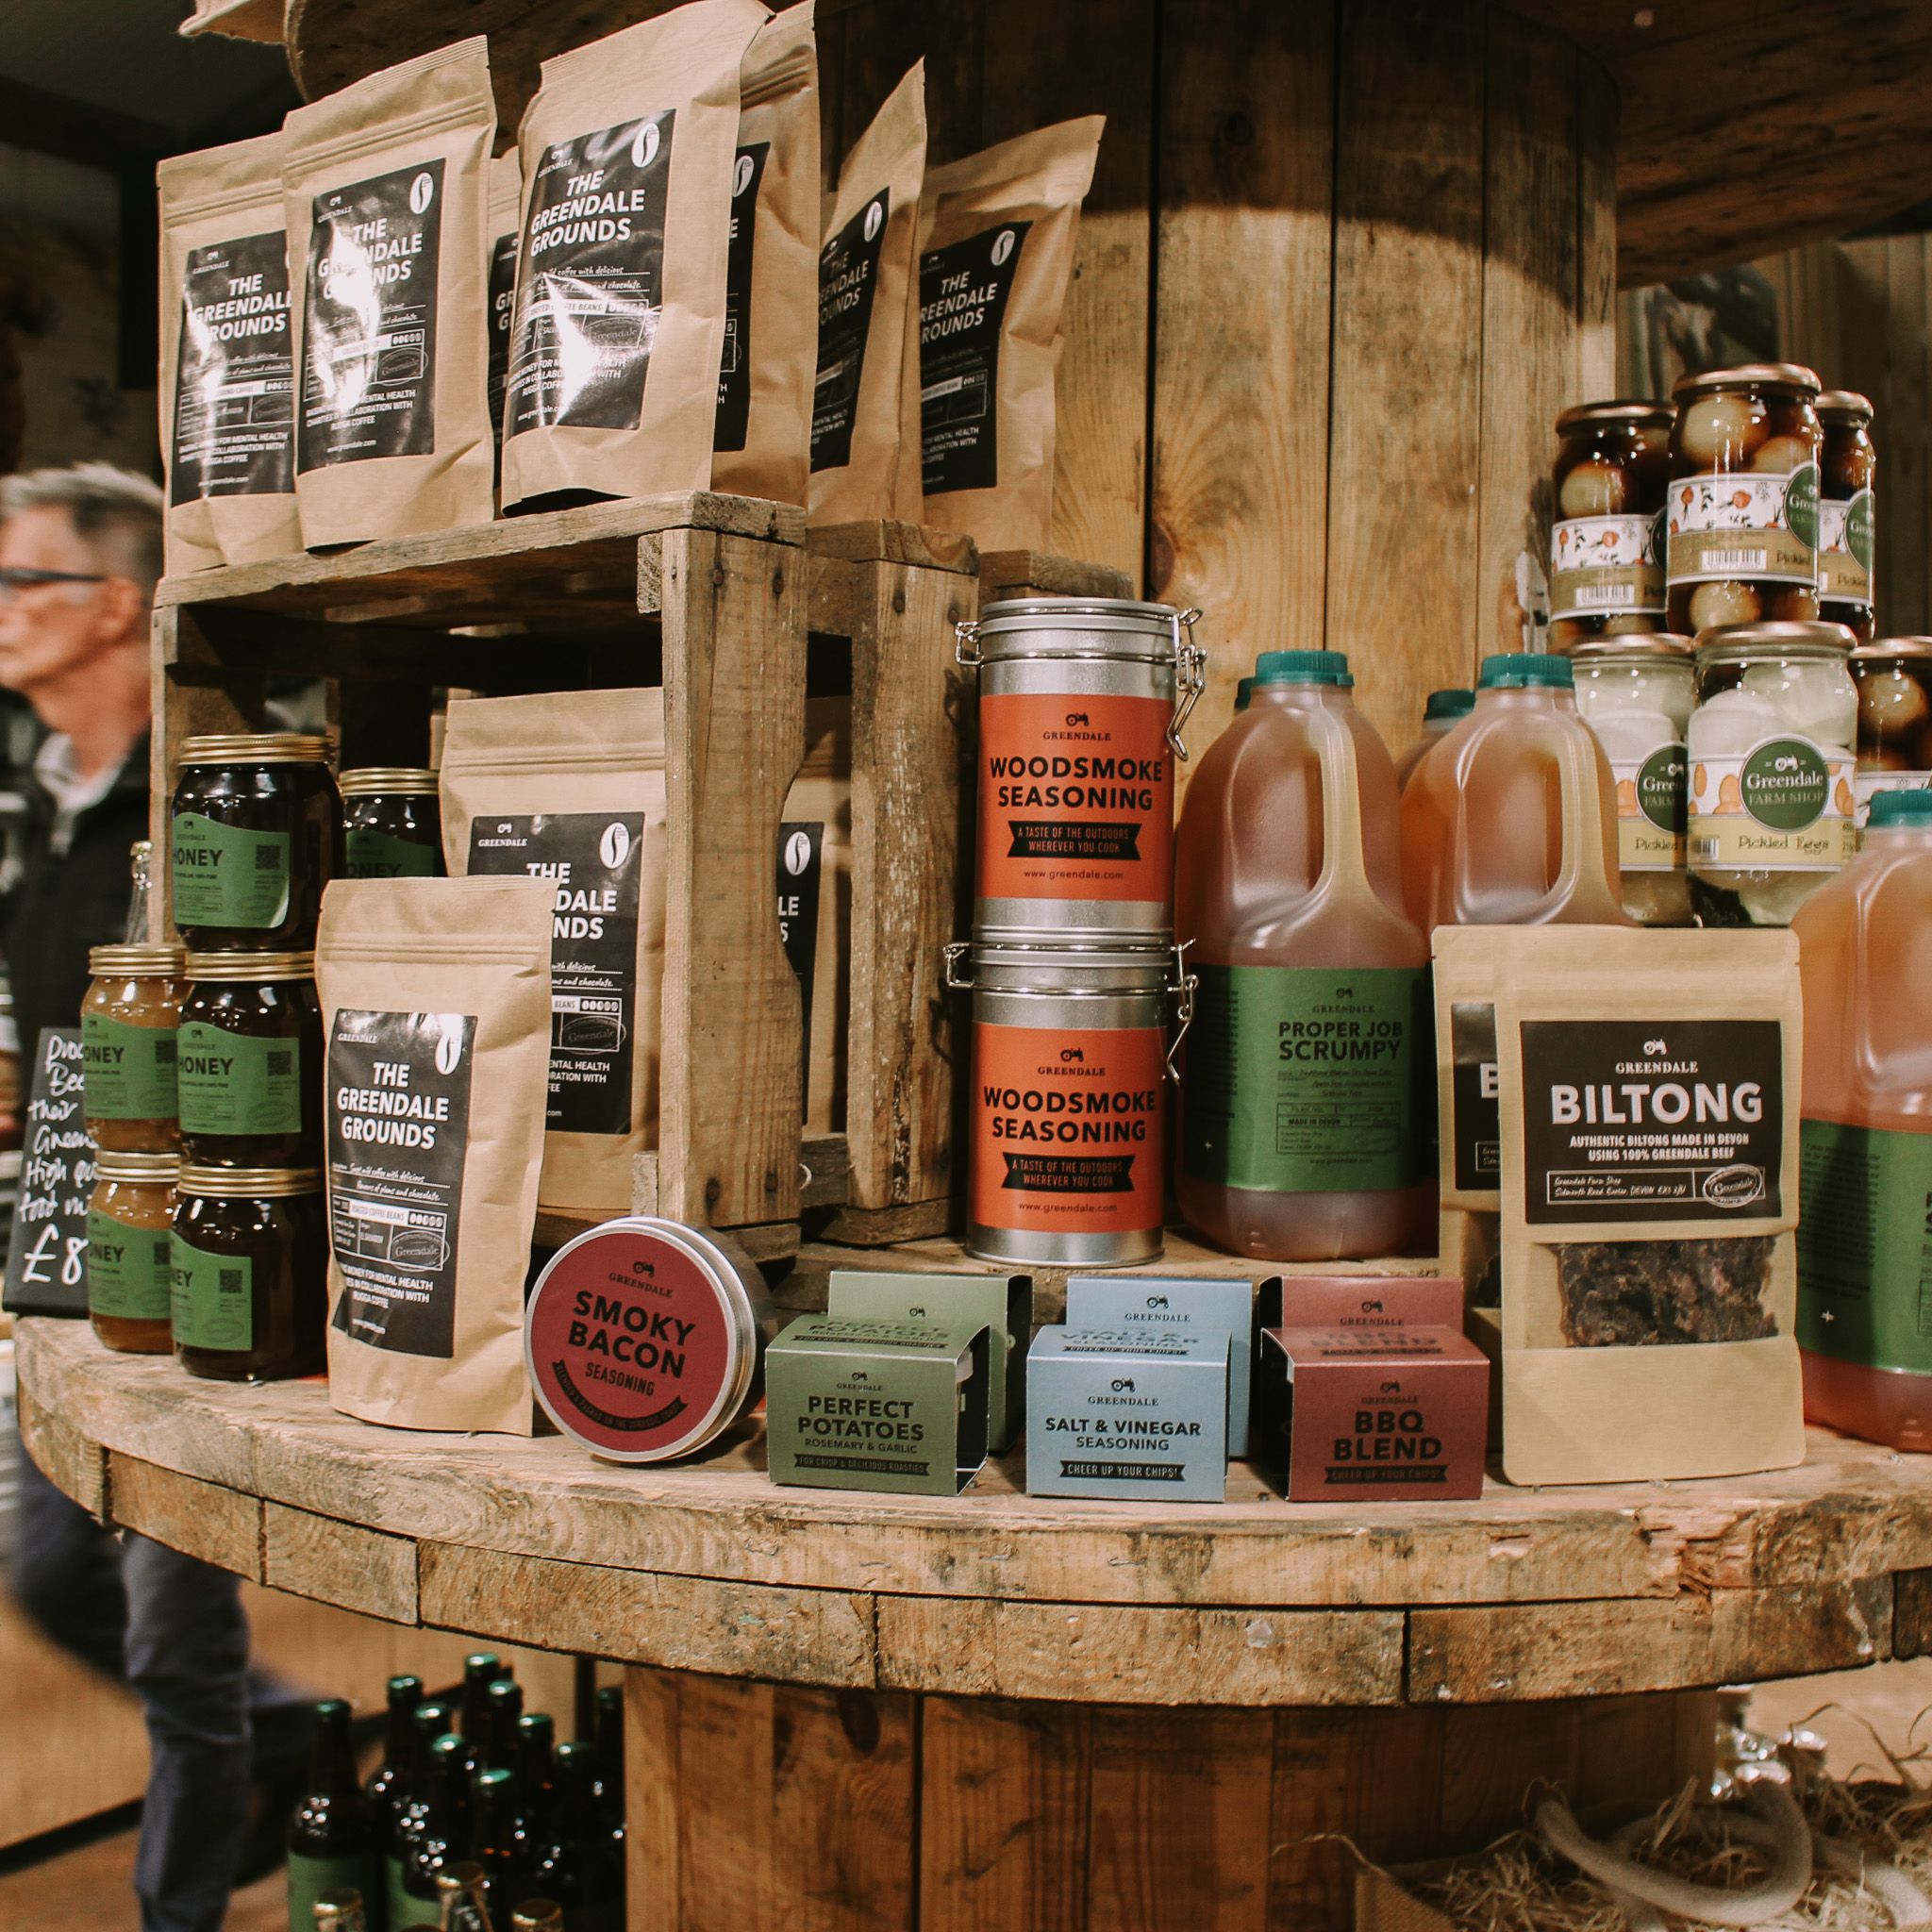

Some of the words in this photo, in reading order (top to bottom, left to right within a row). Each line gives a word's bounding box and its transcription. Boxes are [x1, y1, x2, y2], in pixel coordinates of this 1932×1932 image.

[566, 169, 605, 197] THE
[530, 189, 645, 235] GREENDALE
[351, 218, 388, 243] THE
[530, 217, 632, 258] GROUNDS
[228, 274, 263, 296] THE
[941, 271, 971, 295] THE
[820, 287, 860, 325] OUNDS
[921, 282, 998, 322] REENDALE
[208, 313, 287, 342] ROUNDS
[921, 307, 985, 344] ROUNDS
[1042, 731, 1111, 741] GREENDALE
[990, 756, 1162, 782] WOODSMOKE
[1746, 771, 1824, 790] Greendale
[998, 786, 1153, 810] SEASONING
[1748, 793, 1786, 806] FARM
[1790, 791, 1824, 804] SHOP
[1018, 826, 1024, 838] A
[1025, 826, 1049, 838] TASTE
[1052, 826, 1063, 838] OF
[1067, 827, 1082, 839] THE
[1085, 827, 1129, 840] OUTDOORS
[1738, 834, 1789, 848] Pickled
[477, 838, 528, 848] GREENDALE
[1028, 841, 1074, 852] WHEREVER
[1077, 841, 1094, 853] YOU
[1097, 841, 1120, 854] COOK
[175, 848, 224, 867] ONEY
[1024, 869, 1124, 880] www.greendale.com
[554, 1000, 576, 1008] BEANS
[1312, 1005, 1374, 1013] GREENDALE
[337, 1032, 377, 1044] GREENDALE
[1279, 1022, 1360, 1038] PROPER
[1366, 1022, 1404, 1038] JOB
[83, 1045, 125, 1064] ONEY
[1279, 1040, 1402, 1061] SCRUMPY
[373, 1061, 410, 1088] THE
[575, 1060, 610, 1072] HEALTH
[1038, 1066, 1106, 1076] GREENDALE
[1615, 1060, 1699, 1074] GREENDALE
[582, 1073, 608, 1084] WITH
[337, 1087, 450, 1122] GREENDALE
[984, 1086, 1156, 1114] WOODSMOKE
[1551, 1082, 1763, 1124] BILTONG
[341, 1115, 437, 1150] GROUNDS
[992, 1116, 1145, 1143] SEASONING
[1569, 1134, 1625, 1148] AUTHENTIC
[1627, 1133, 1670, 1147] BILTONG
[1672, 1133, 1702, 1146] MADE
[1704, 1133, 1715, 1146] IN
[1717, 1132, 1750, 1145] DEVON
[1588, 1149, 1621, 1162] USING
[1622, 1148, 1650, 1161] 100%
[1652, 1147, 1709, 1161] GREENDALE
[1711, 1146, 1735, 1159] BEEF
[1012, 1159, 1018, 1170] A
[1021, 1159, 1043, 1172] TASTE
[1046, 1161, 1058, 1173] OF
[1061, 1161, 1076, 1173] THE
[1023, 1174, 1069, 1186] WHEREVER
[1072, 1175, 1089, 1187] YOU
[1018, 1202, 1118, 1214] www.greendale.com
[398, 1276, 433, 1291] HEALTH
[608, 1273, 674, 1299] GREENDALE
[406, 1290, 430, 1303] WITH
[573, 1290, 696, 1346] SMOKY
[1124, 1312, 1191, 1323] GREENDALE
[1340, 1317, 1405, 1326] GREENDALE
[568, 1320, 686, 1378] BACON
[585, 1361, 656, 1397] SEASONING
[837, 1383, 882, 1391] GREENDALE
[808, 1395, 914, 1419] PERFECT
[1088, 1395, 1159, 1407] GREENDALE
[797, 1416, 924, 1441] POTATOES
[1045, 1417, 1090, 1433] SALT
[1094, 1418, 1108, 1434] &
[1114, 1420, 1201, 1436] VINEGAR
[1355, 1409, 1424, 1434] BBQ
[805, 1438, 864, 1450] ROSEMARY
[867, 1441, 875, 1451] &
[878, 1442, 918, 1454] GARLIC
[1076, 1436, 1170, 1451] SEASONING
[1333, 1437, 1442, 1461] BLEND
[1067, 1463, 1098, 1474] CHEER
[1101, 1464, 1114, 1476] UP
[1117, 1465, 1142, 1476] YOUR
[1145, 1466, 1178, 1478] CHIPS!
